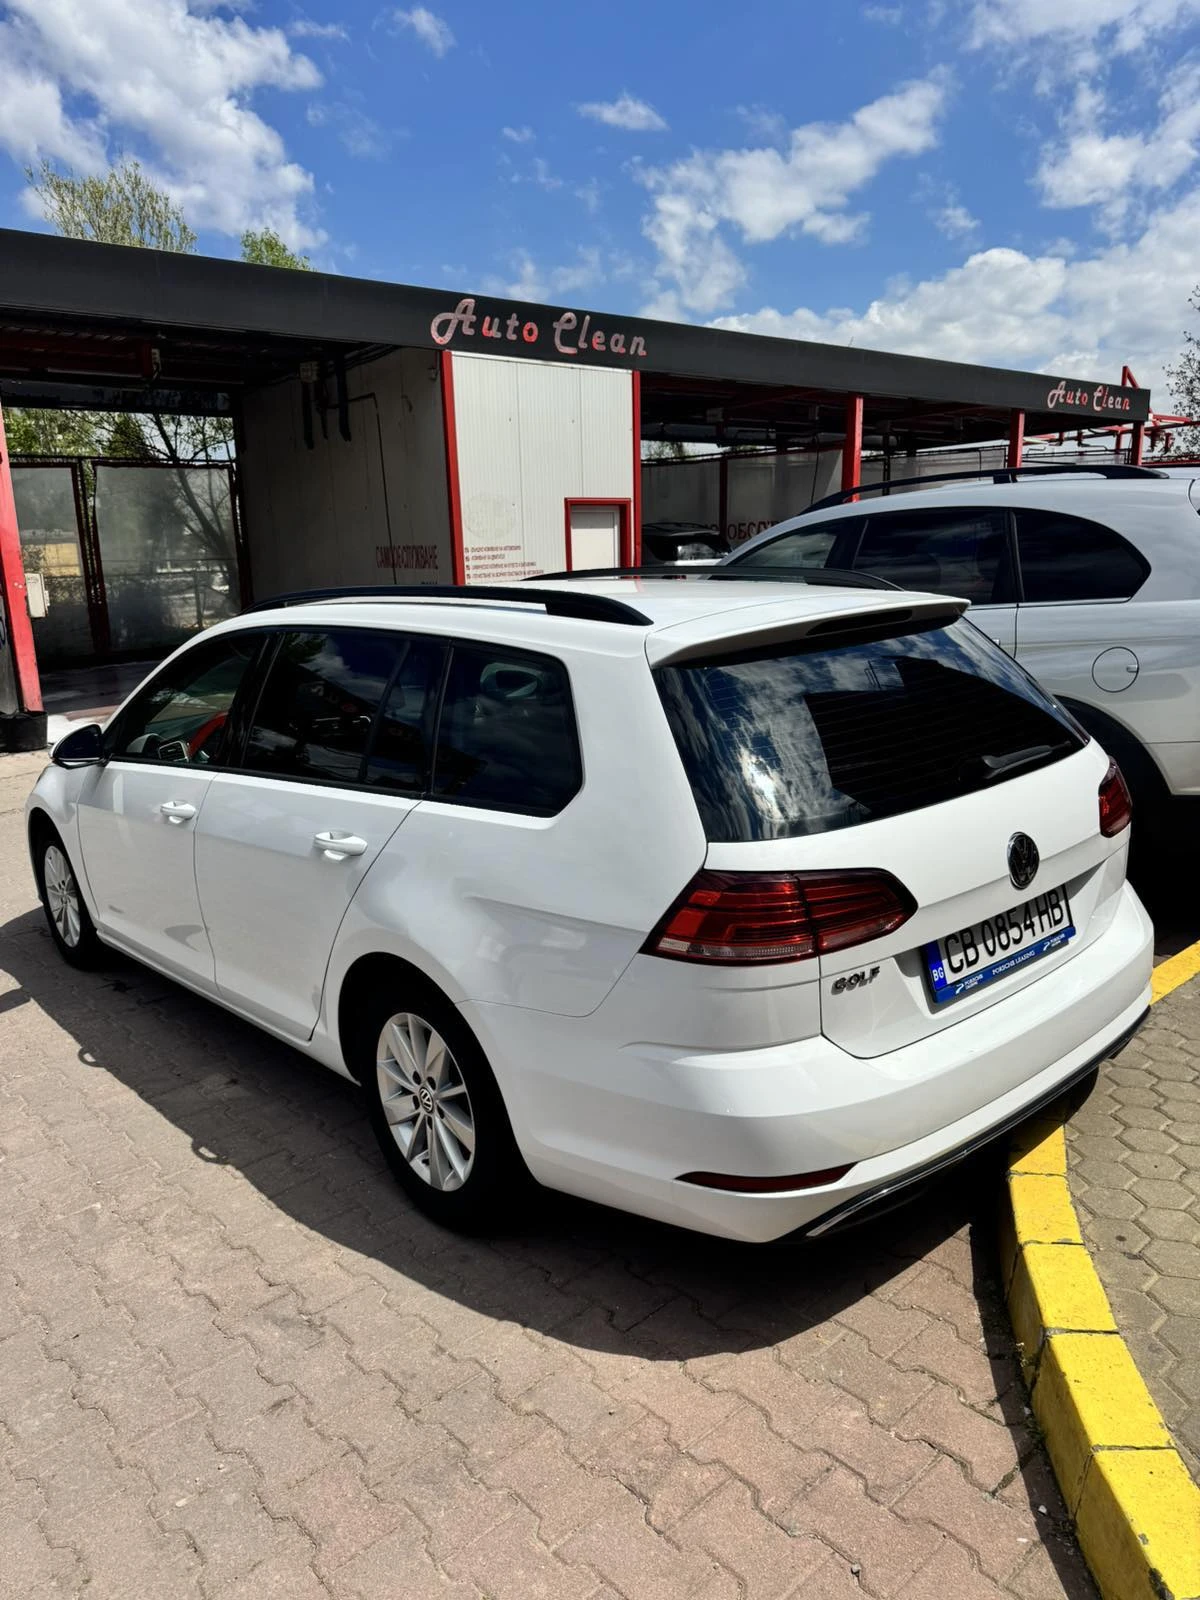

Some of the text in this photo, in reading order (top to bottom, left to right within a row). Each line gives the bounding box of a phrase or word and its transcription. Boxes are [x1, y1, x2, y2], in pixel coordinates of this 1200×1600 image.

[430, 298, 648, 357] Auto Clean
[1047, 380, 1130, 412] Auto Clean
[944, 889, 1064, 974] CB 0854 HB
[833, 966, 880, 991] GOLF
[932, 966, 945, 981] BG
